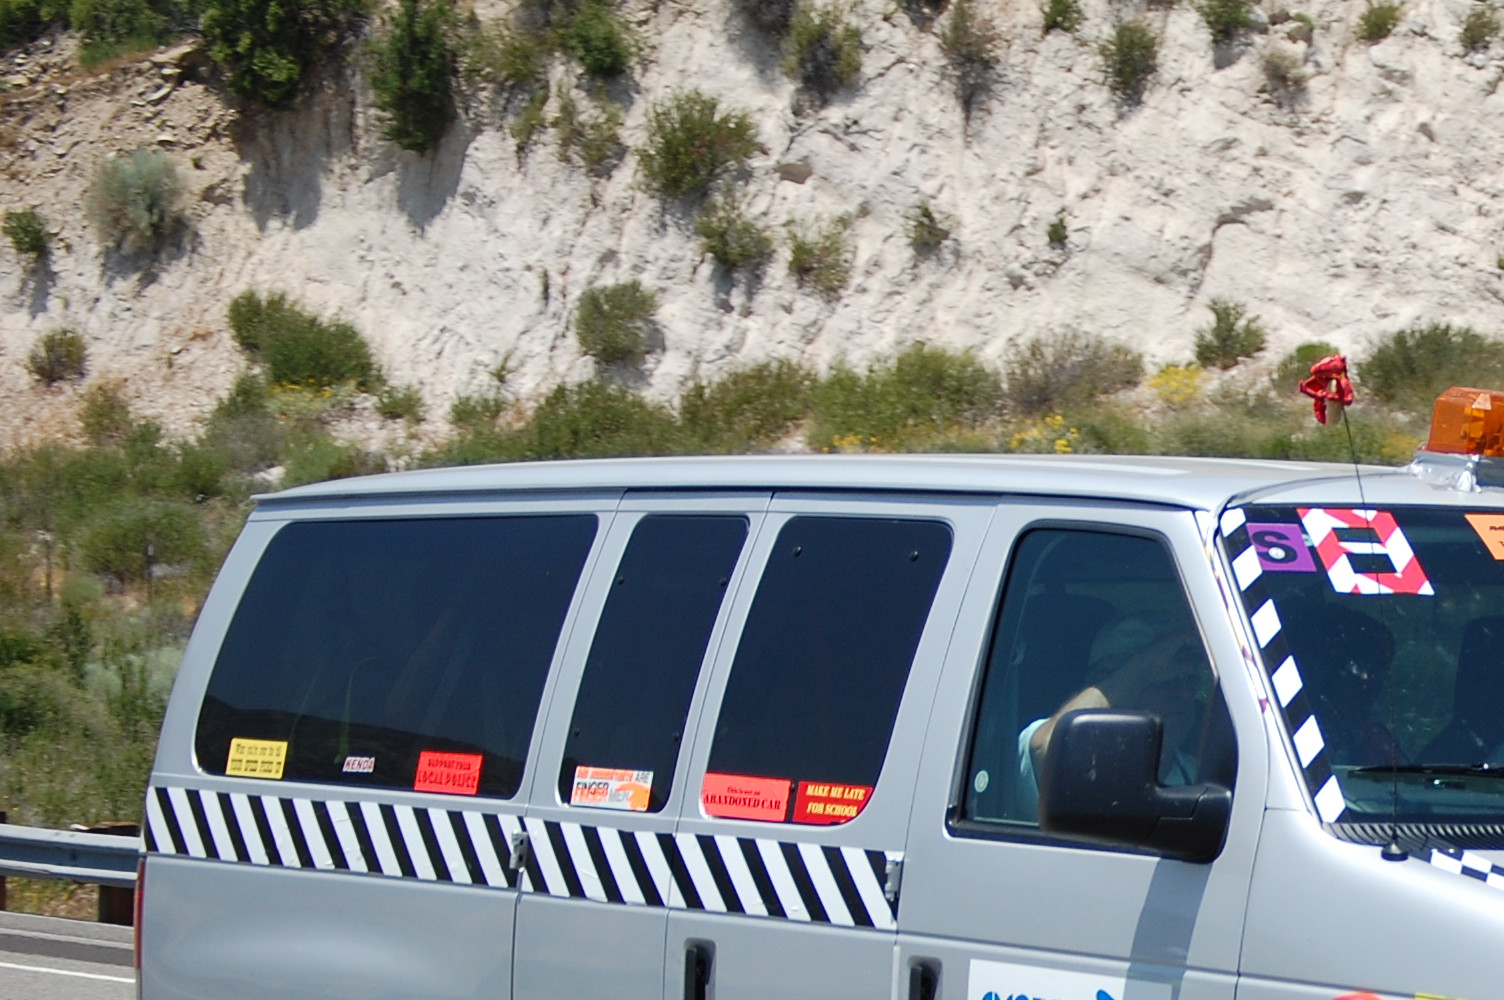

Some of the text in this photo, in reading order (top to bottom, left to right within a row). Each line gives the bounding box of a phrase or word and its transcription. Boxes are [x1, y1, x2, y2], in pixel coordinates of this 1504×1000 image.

[806, 785, 866, 800] MAKE ME LATE
[704, 793, 781, 809] ABANDONED CAR
[807, 802, 858, 817] FOR SCHOOL
